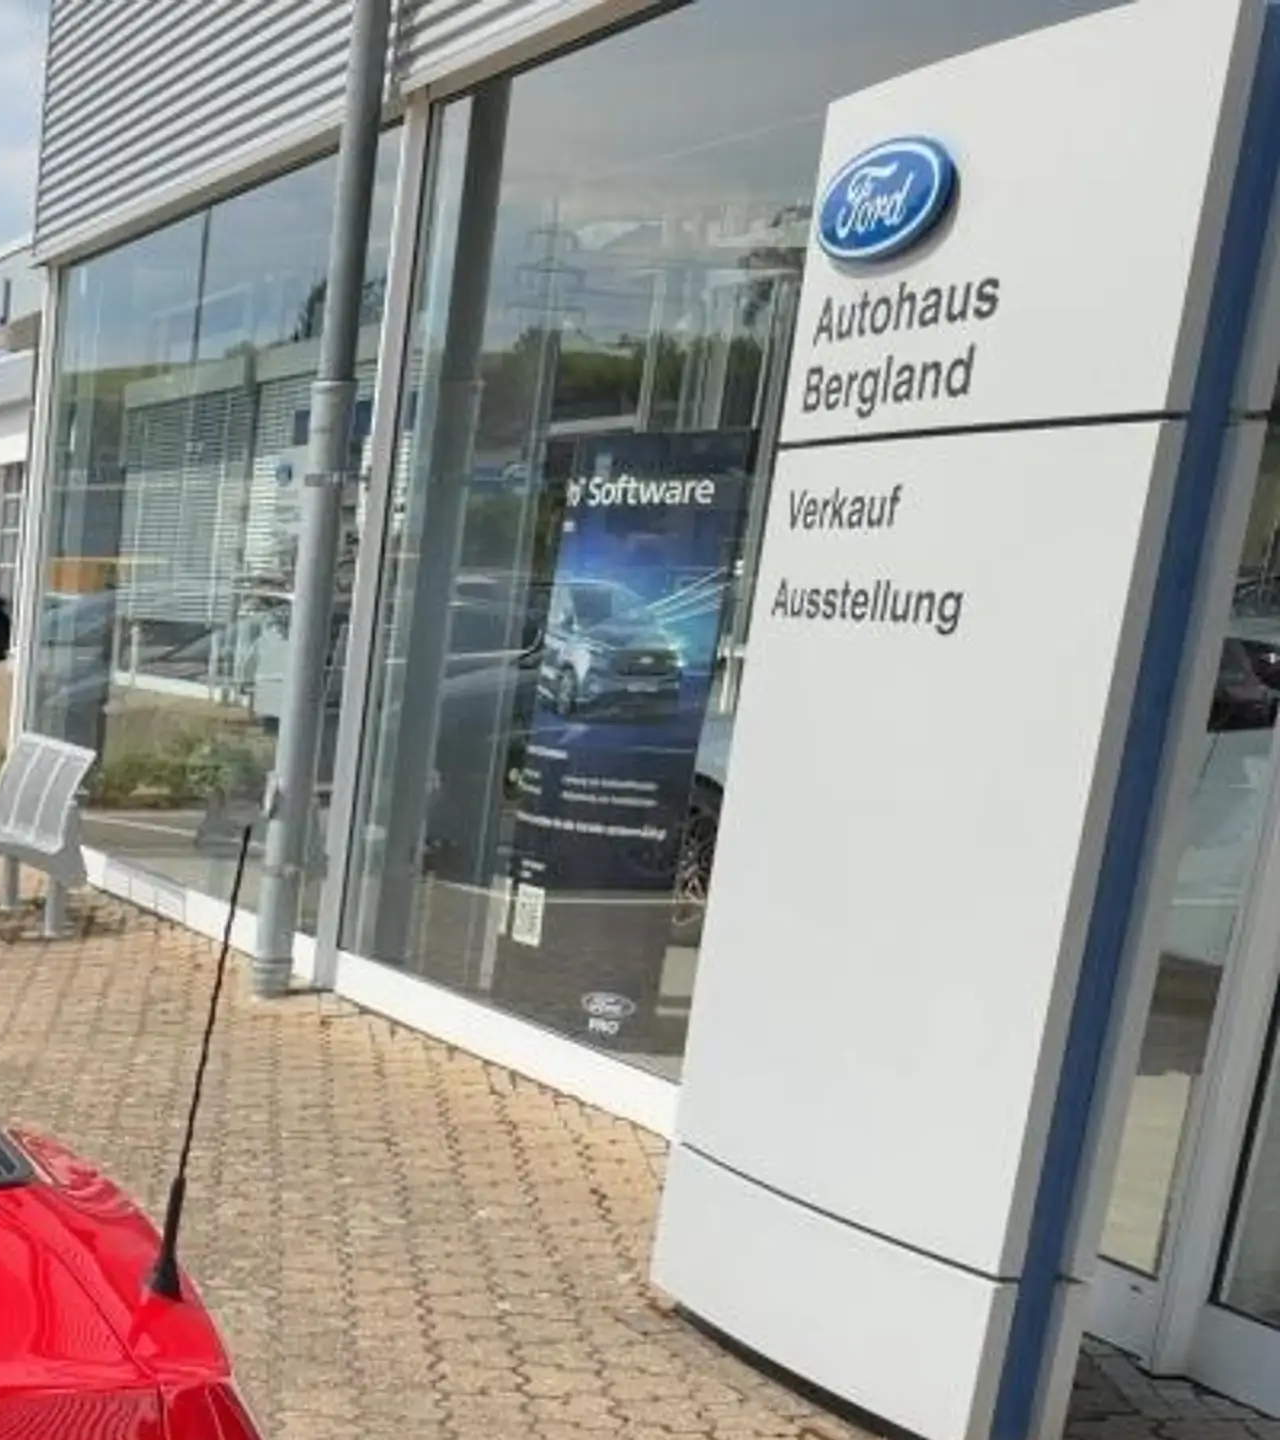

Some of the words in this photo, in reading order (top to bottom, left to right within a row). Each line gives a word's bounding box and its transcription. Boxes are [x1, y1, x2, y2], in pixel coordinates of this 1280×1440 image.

[834, 160, 915, 240] Ford
[812, 277, 1001, 346] Autohaus
[801, 342, 978, 420] Bergland
[587, 473, 716, 507] Software
[789, 484, 903, 531] Verkauf
[771, 577, 964, 636] Ausstellung
